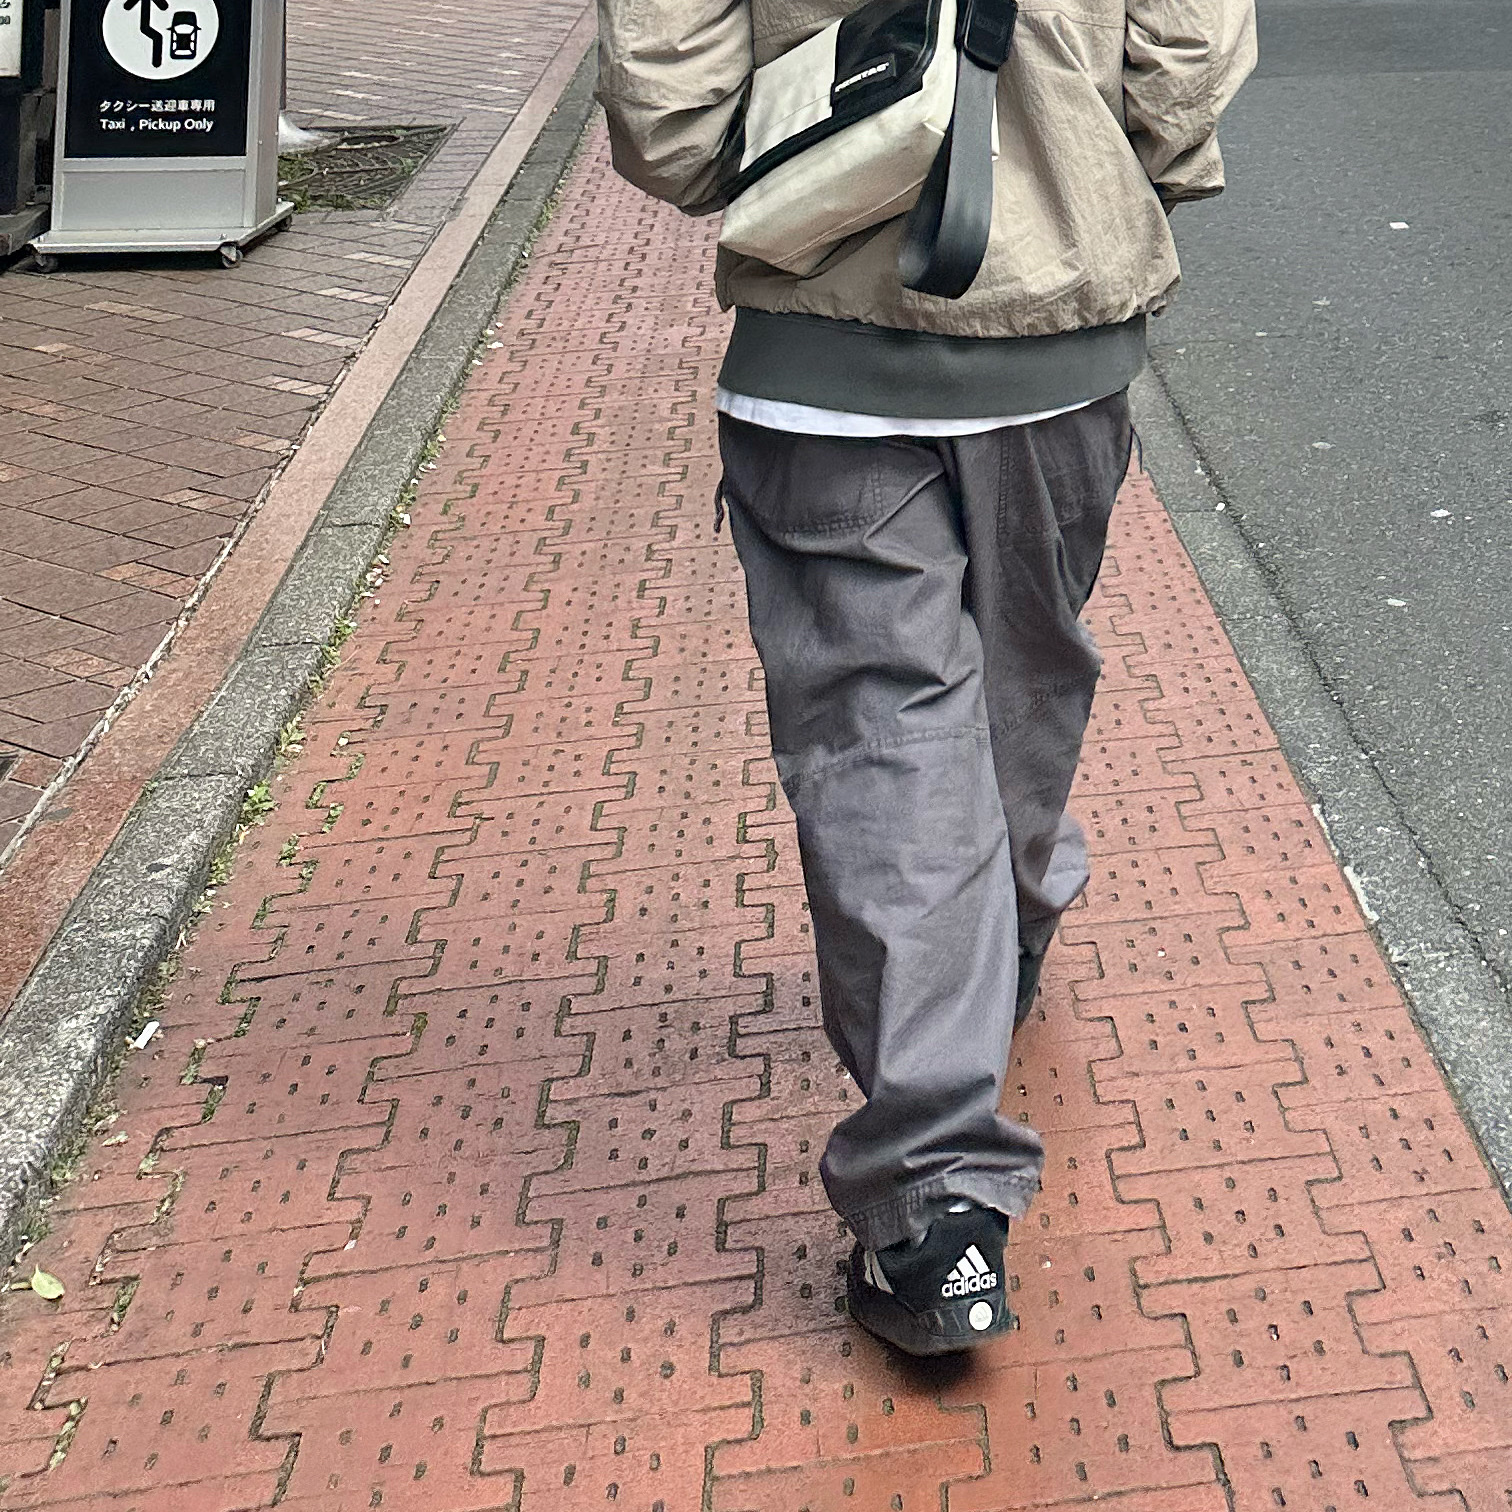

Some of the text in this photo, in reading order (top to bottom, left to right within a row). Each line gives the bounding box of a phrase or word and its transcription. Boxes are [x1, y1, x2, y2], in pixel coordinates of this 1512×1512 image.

[99, 99, 216, 113] タクシー送迎車専用
[99, 118, 126, 131] Taxi
[139, 118, 181, 132] Pickup
[184, 118, 214, 132] Only
[941, 1272, 998, 1298] adidas
